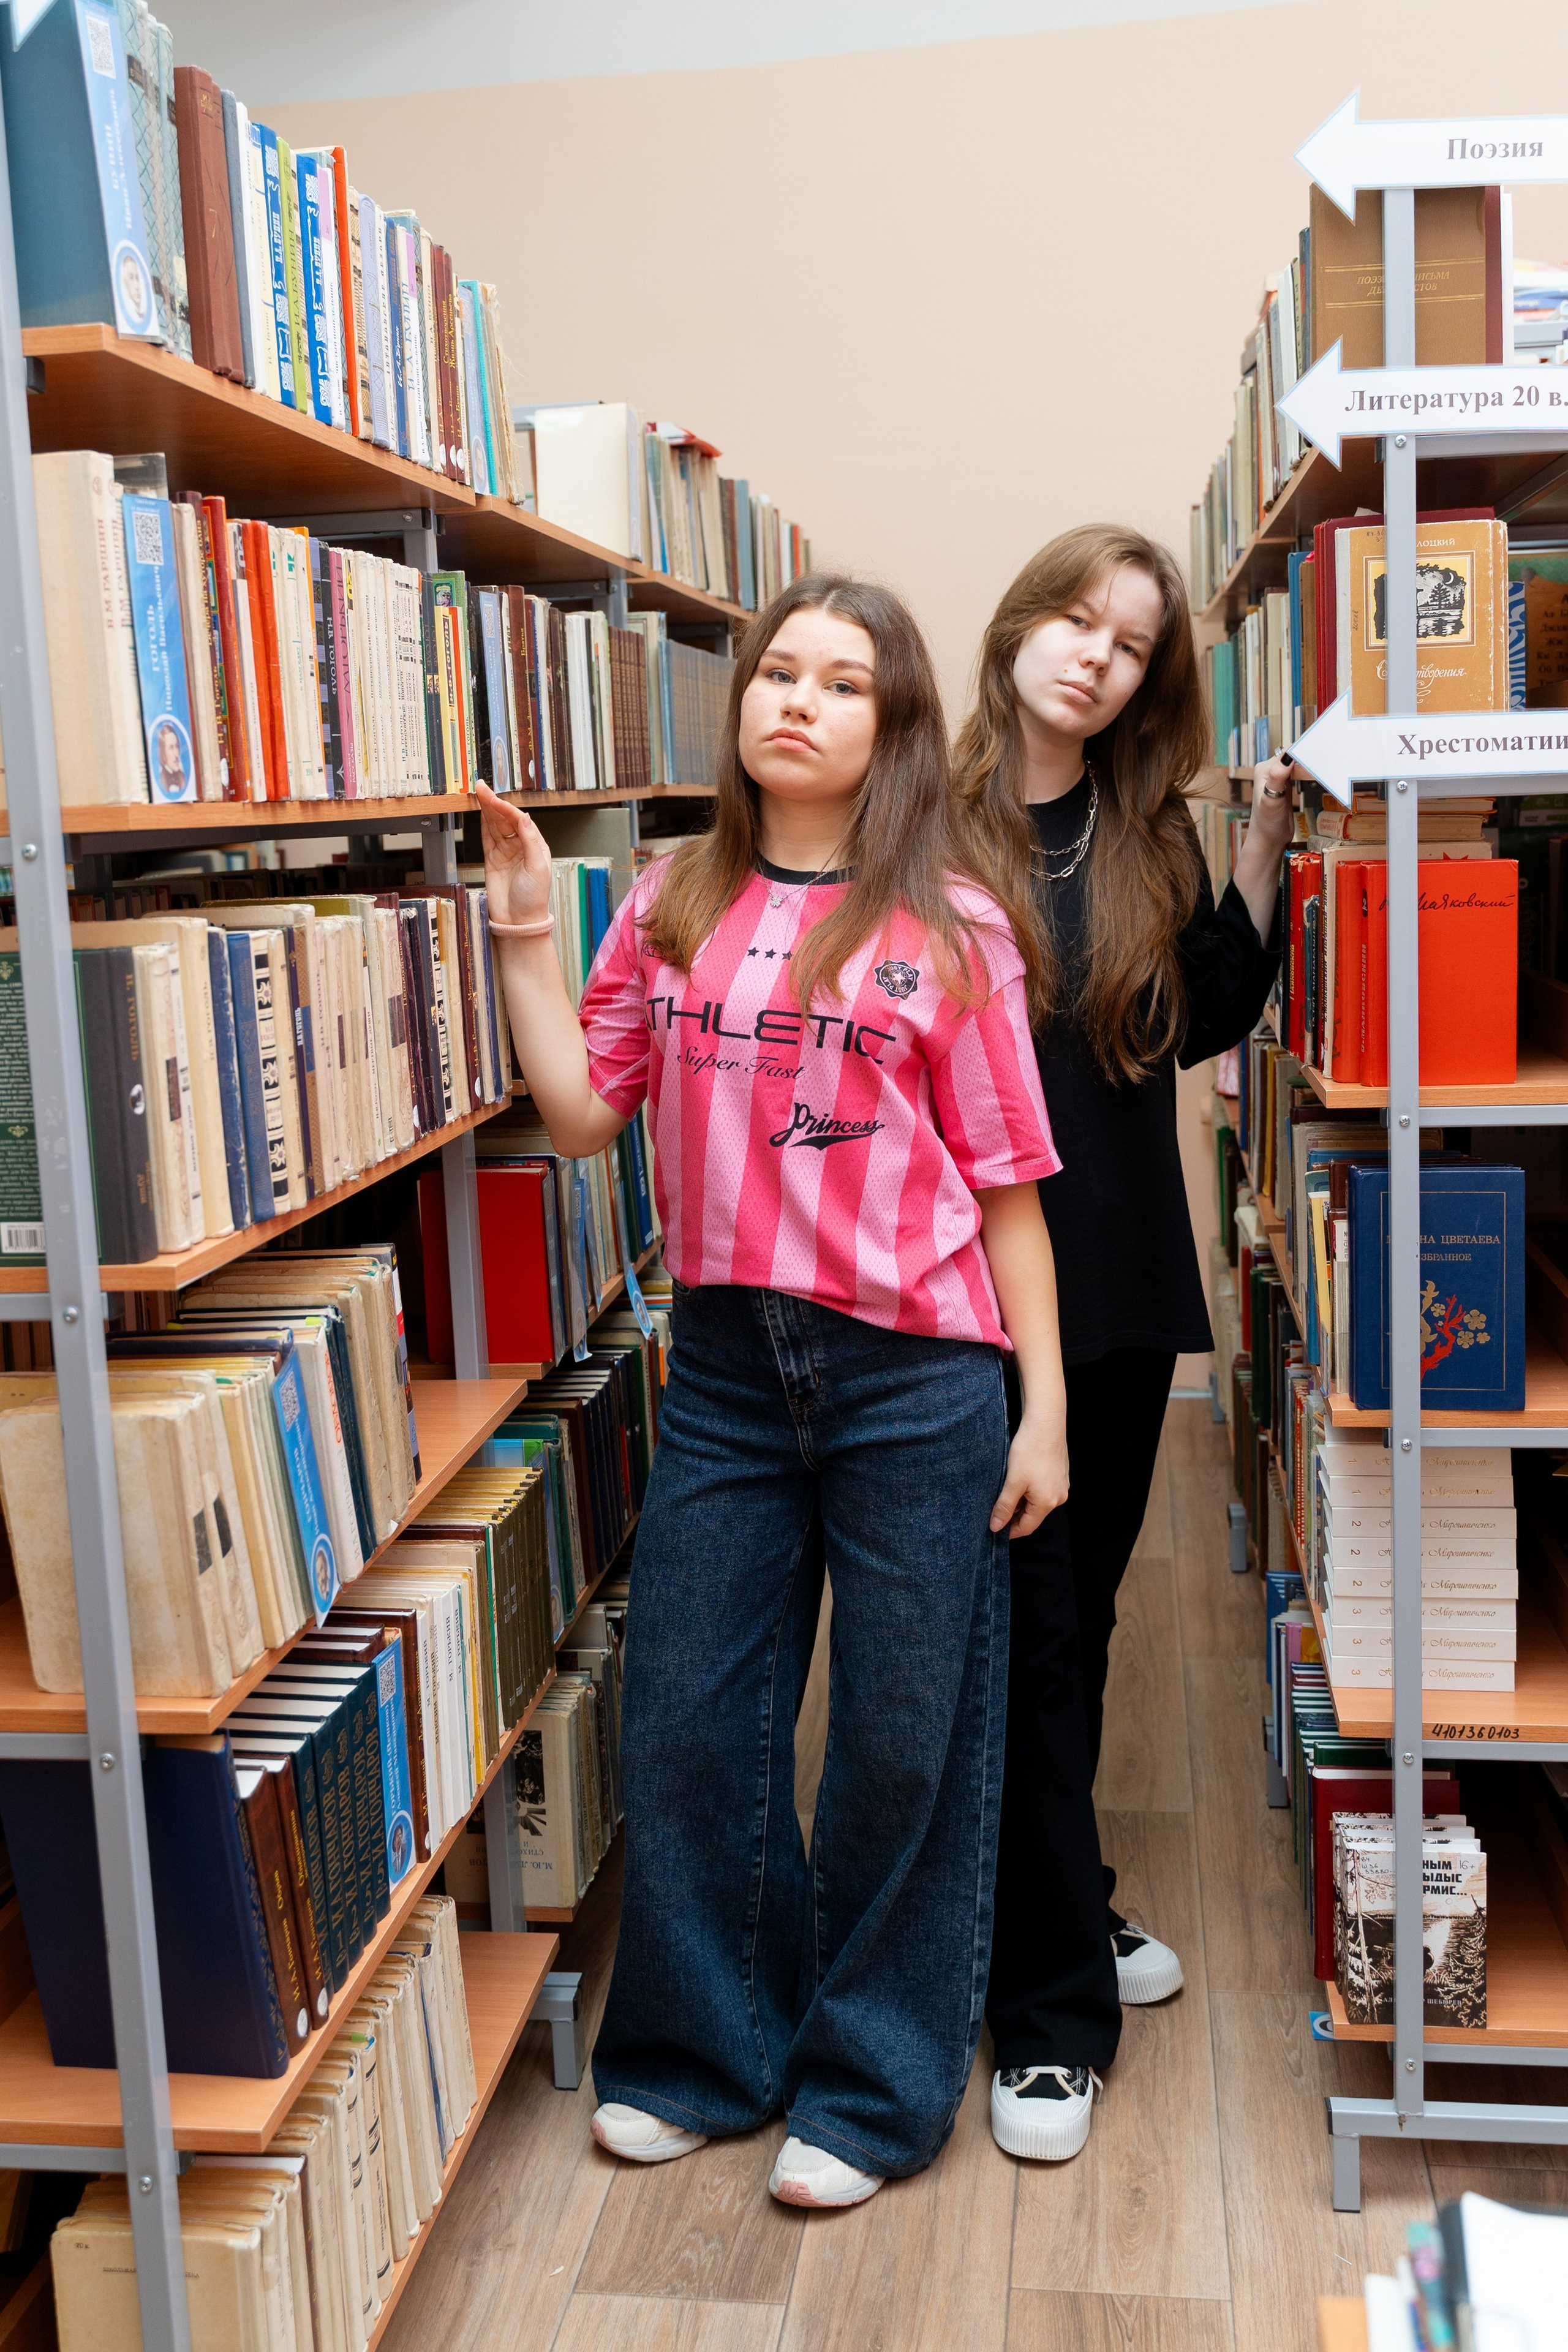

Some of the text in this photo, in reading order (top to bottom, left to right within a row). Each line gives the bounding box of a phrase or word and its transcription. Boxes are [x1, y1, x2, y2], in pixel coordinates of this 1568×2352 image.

[1447, 138, 1543, 160] Поэзия
[1357, 275, 1385, 285] ПОЭЗ
[1344, 389, 1504, 415] Литература
[1512, 386, 1540, 407] 20
[1415, 538, 1455, 548] ЛОЦКИЙ
[1396, 733, 1568, 760] Хрестоматии
[1362, 897, 1368, 911] 2
[903, 968, 913, 981] PLAY
[883, 977, 894, 990] PLAY
[677, 1046, 807, 1080] Super Fast
[769, 1102, 886, 1148] Princess
[1441, 1235, 1501, 1245] ЦВЕТАЕВА
[1430, 1519, 1496, 1530] Мирошниченко
[1429, 1548, 1494, 1559] Мирошниченко
[1430, 1580, 1497, 1591] Мирошниченко
[1430, 1607, 1496, 1618] Мирошниченко
[1430, 1638, 1496, 1649] Мирошниченко
[1429, 1669, 1494, 1680] Мирошниченко
[1431, 1722, 1520, 1740] 4101360103
[1459, 1860, 1476, 1870] 16+
[1423, 1885, 1468, 1896] РМИС...
[274, 1869, 294, 1970] Гончаров Обрыв
